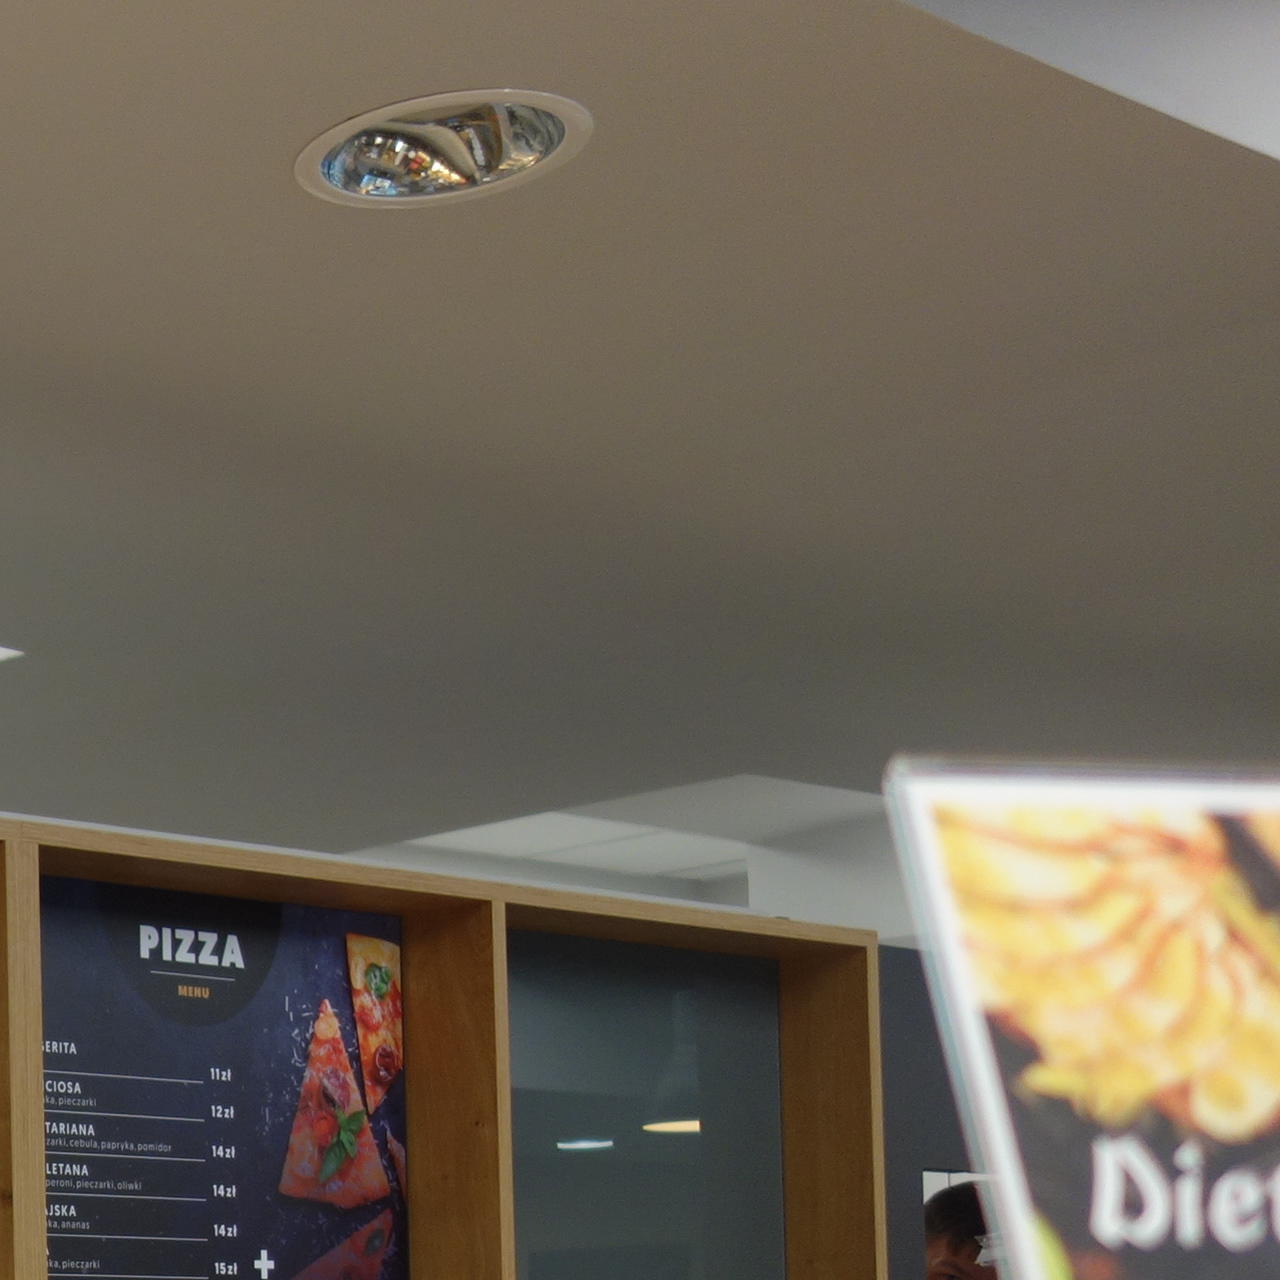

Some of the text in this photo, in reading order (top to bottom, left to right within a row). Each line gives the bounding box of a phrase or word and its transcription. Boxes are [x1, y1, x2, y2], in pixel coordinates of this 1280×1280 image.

[140, 924, 245, 969] PIZZA
[178, 985, 209, 999] MENU
[45, 1080, 81, 1094] CIOSA
[58, 1096, 97, 1107] pieczarki
[45, 1121, 95, 1136] TARIANA
[137, 1142, 172, 1152] pomidor
[46, 1163, 89, 1176] LETANA
[117, 1180, 142, 1190] oliwki
[61, 1220, 90, 1230] ananas
[61, 1259, 100, 1270] pieczarki
